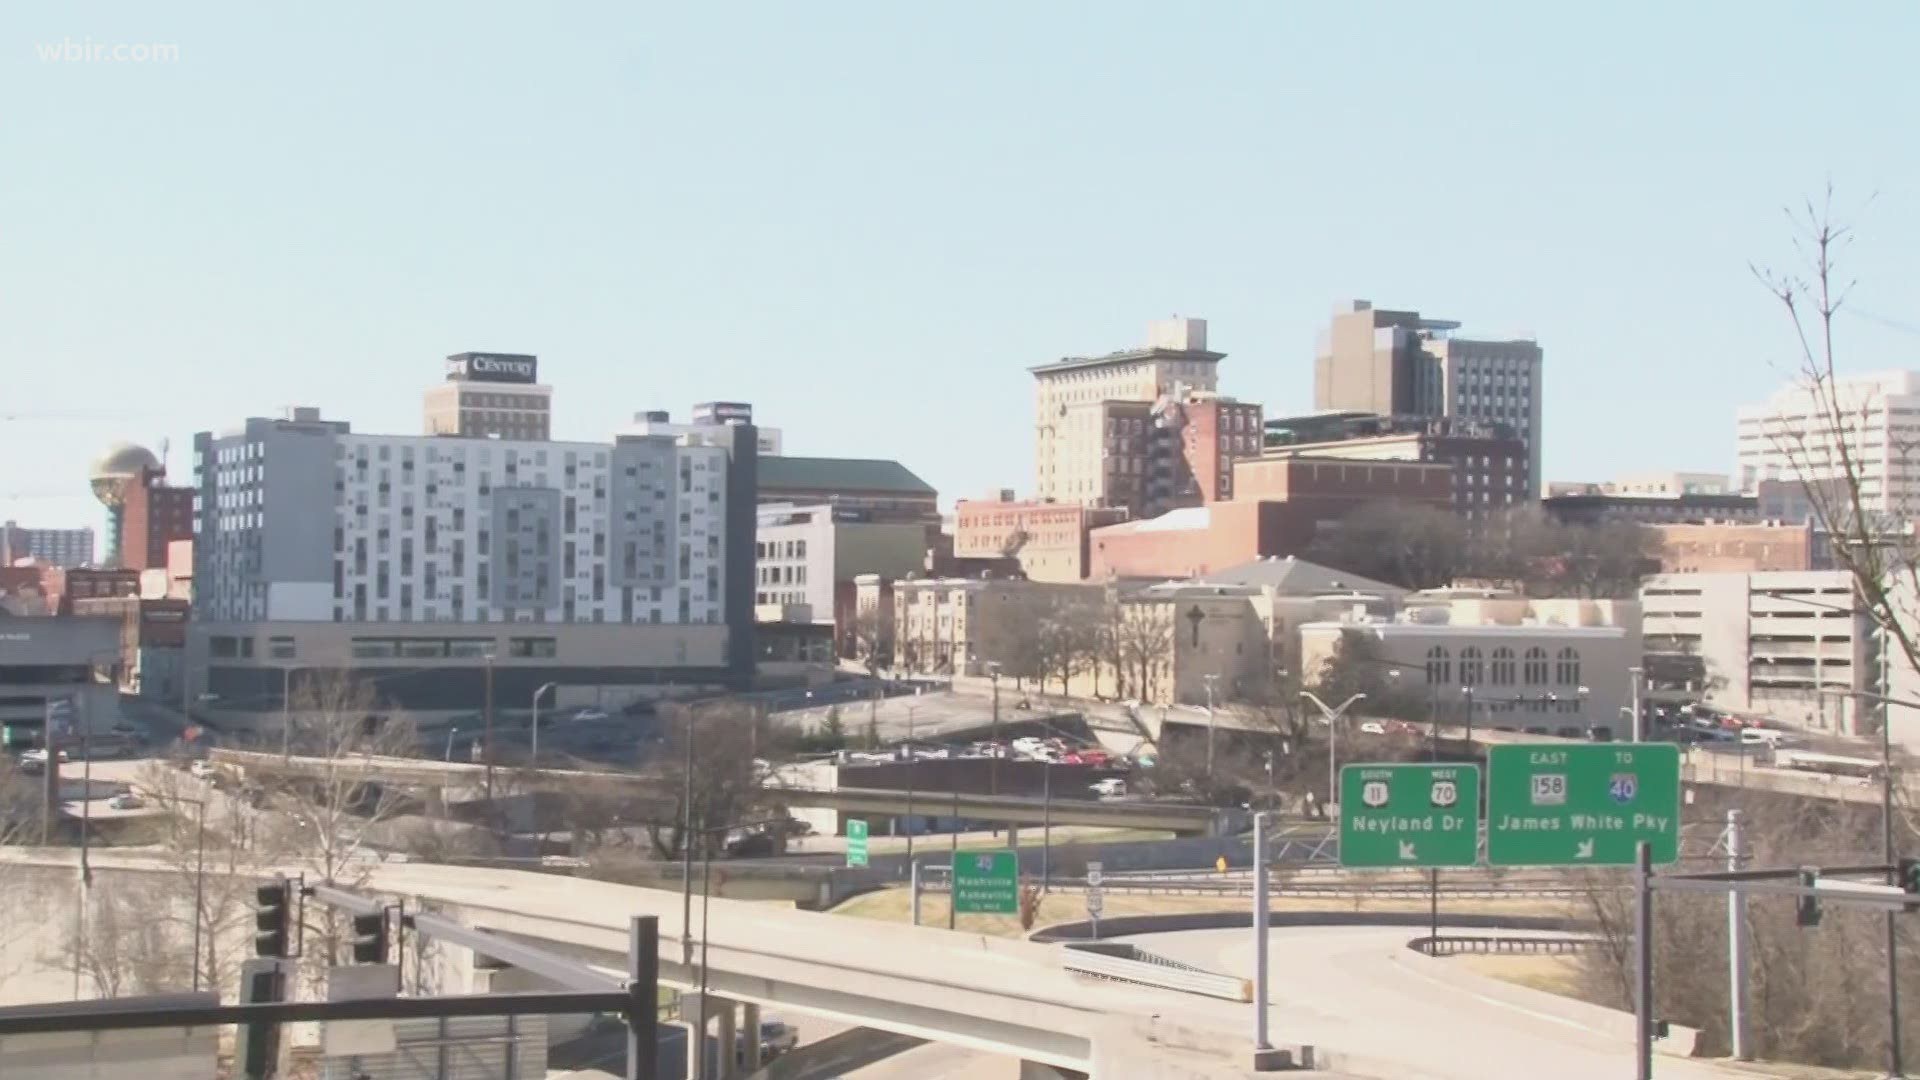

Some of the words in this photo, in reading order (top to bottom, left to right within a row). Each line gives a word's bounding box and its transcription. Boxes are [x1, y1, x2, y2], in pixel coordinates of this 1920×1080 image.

[1530, 752, 1567, 764] EAST
[1615, 752, 1633, 764] TO
[1360, 769, 1393, 779] SOUTH
[1431, 769, 1457, 779] WEST
[1370, 787, 1381, 801] 11
[1435, 786, 1454, 801] 70
[1534, 777, 1563, 794] 158
[1610, 779, 1635, 798] 40
[1352, 815, 1433, 834] Neyland
[1442, 815, 1464, 831] Dr
[1498, 815, 1560, 831] James
[1570, 815, 1624, 831] White
[1633, 813, 1668, 832] Pky
